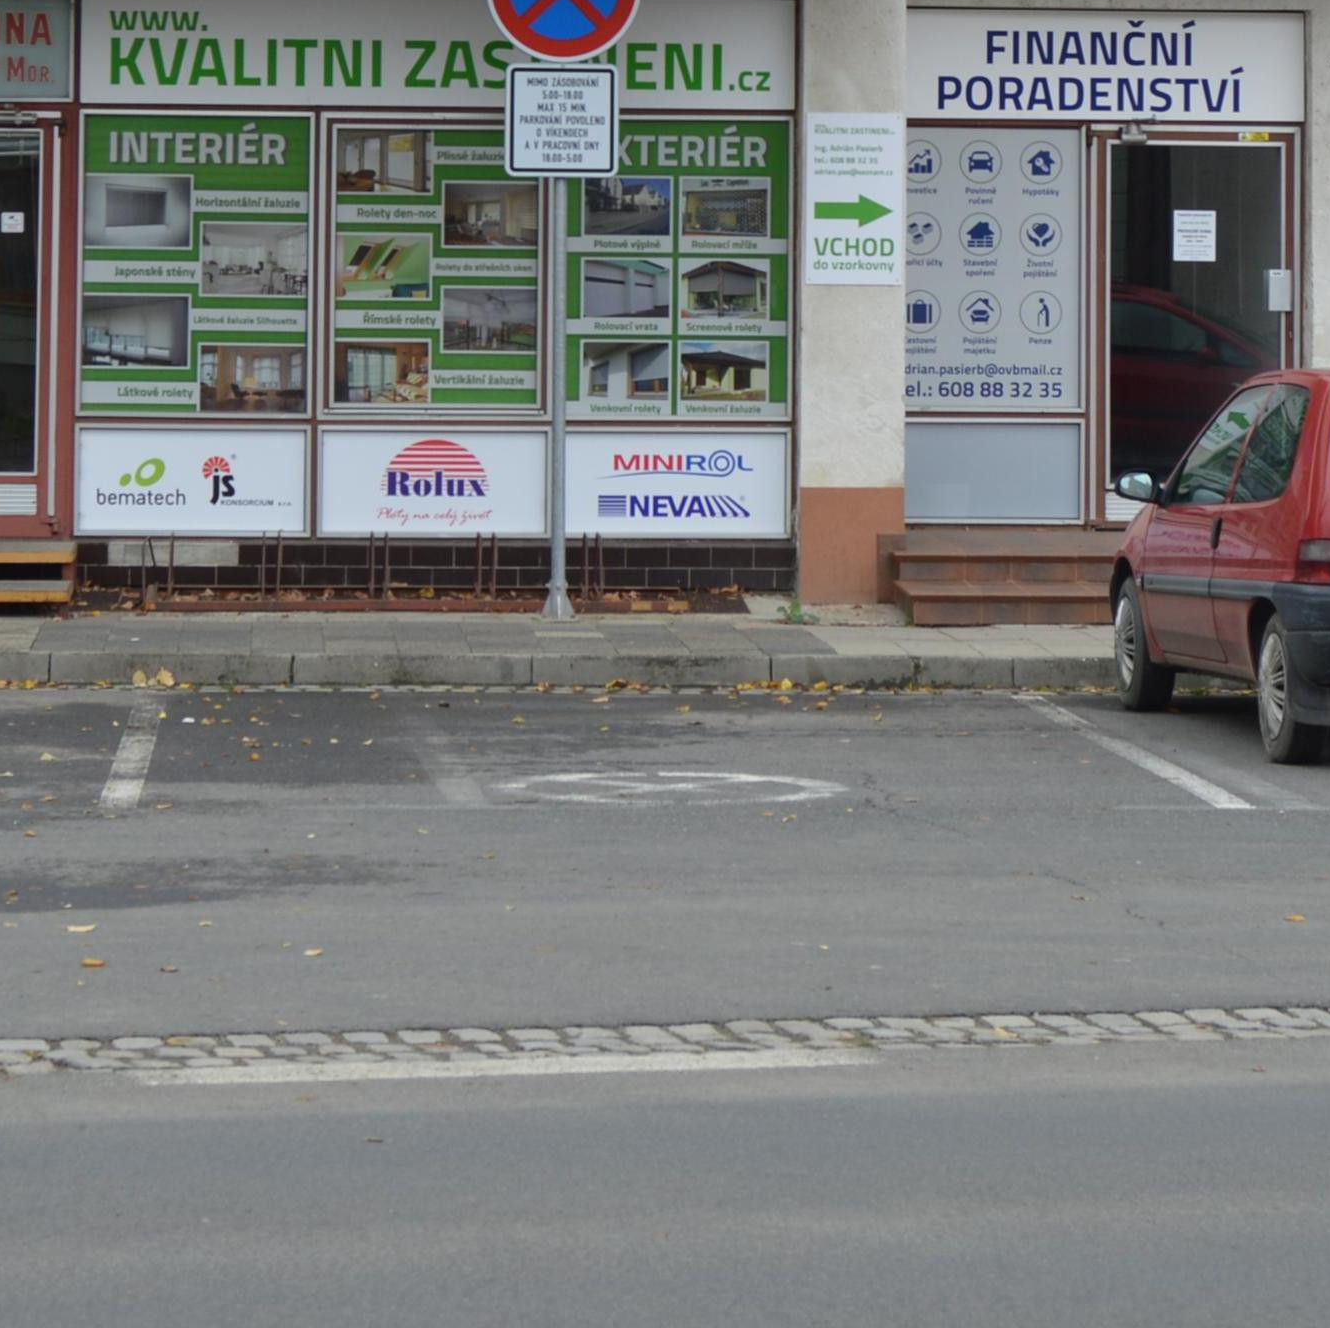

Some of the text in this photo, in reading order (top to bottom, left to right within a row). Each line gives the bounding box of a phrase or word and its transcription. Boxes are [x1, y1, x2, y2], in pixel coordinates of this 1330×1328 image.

[986, 20, 1196, 66] FINANČNÍ
[110, 36, 382, 88] KVALITNI
[527, 76, 599, 88] MIMO ZÁSOBOVÁNÍ
[937, 66, 1244, 113] PORADENSTVÍ
[537, 103, 555, 112] MAX
[559, 102, 567, 112] 15
[519, 114, 606, 126] PARKOVÁNÍ POVOLENO
[536, 126, 589, 139] O VÍKENDECH
[109, 122, 287, 165] INTERIÉR
[525, 139, 600, 151] A V PRACOVNÍ DNY
[437, 150, 468, 161] Plissé
[906, 187, 938, 195] nvestice
[965, 186, 996, 196] Povinné
[195, 196, 301, 210] Horizontální žaluzie
[968, 196, 994, 205] ručení
[357, 207, 437, 220] Rolety den-noc
[594, 239, 661, 251] Plotové výplně
[691, 240, 758, 250] Rolovací mříže
[814, 237, 895, 257] VCHOD
[813, 259, 894, 274] do vzorkovny
[963, 258, 997, 268] Stavební
[1026, 258, 1054, 269] Životní
[115, 266, 197, 279] Japonské stěny
[363, 312, 437, 327] Římské rolety
[594, 321, 633, 331] Rolovací
[686, 322, 763, 334] Screenové rolety
[905, 336, 936, 345] estovní
[963, 336, 997, 347] Pojištění
[1029, 337, 1052, 345] Penze
[905, 345, 936, 355] ojištění
[964, 346, 996, 356] majetku
[905, 363, 1063, 378] drian.pasierb@ovbmail.cz
[434, 375, 525, 386] Vertikální žaluzie
[117, 387, 194, 399] Látkové rolety
[905, 380, 1063, 399] el.: 608 88 32 35
[590, 404, 662, 416] Venkovní rolety
[686, 404, 762, 415] Venkovní žaluzie
[613, 449, 754, 476] MINIROL
[386, 470, 487, 497] Rolux
[96, 489, 186, 506] bematech
[220, 499, 274, 507] KONSORCIUM
[629, 494, 711, 518] NEVA
[377, 506, 409, 527] Ploty
[413, 512, 430, 520] na
